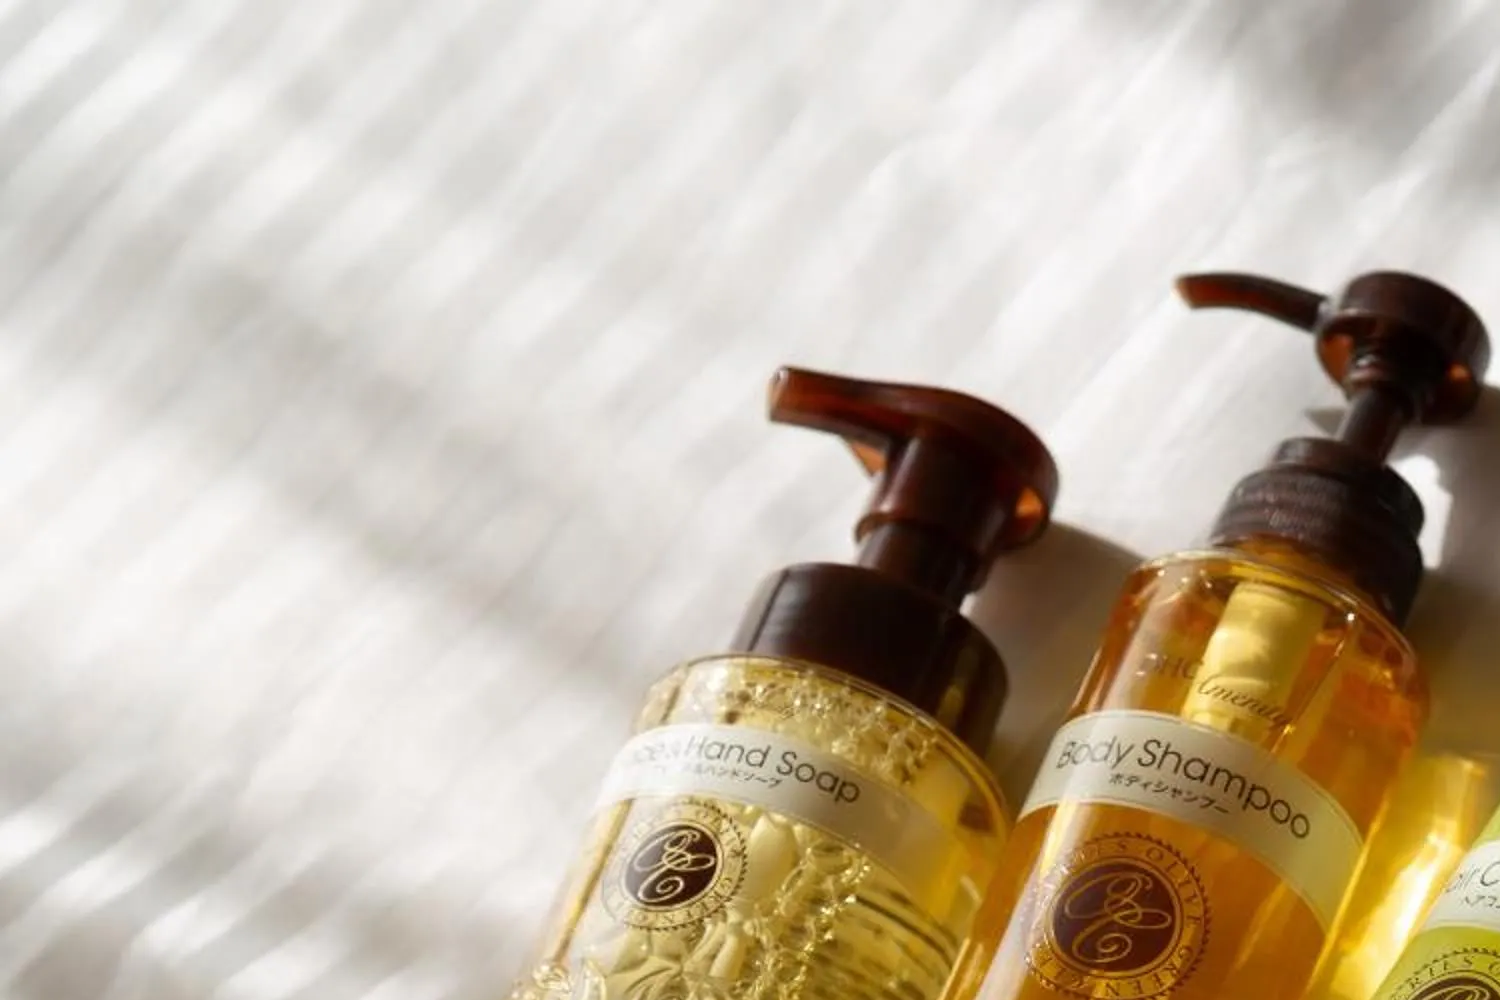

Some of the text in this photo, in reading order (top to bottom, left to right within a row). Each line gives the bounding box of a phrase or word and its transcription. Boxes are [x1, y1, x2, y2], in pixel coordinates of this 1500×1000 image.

[685, 735, 771, 769] Hand
[776, 751, 861, 804] Soap
[1057, 736, 1311, 840] Body Shampoo
